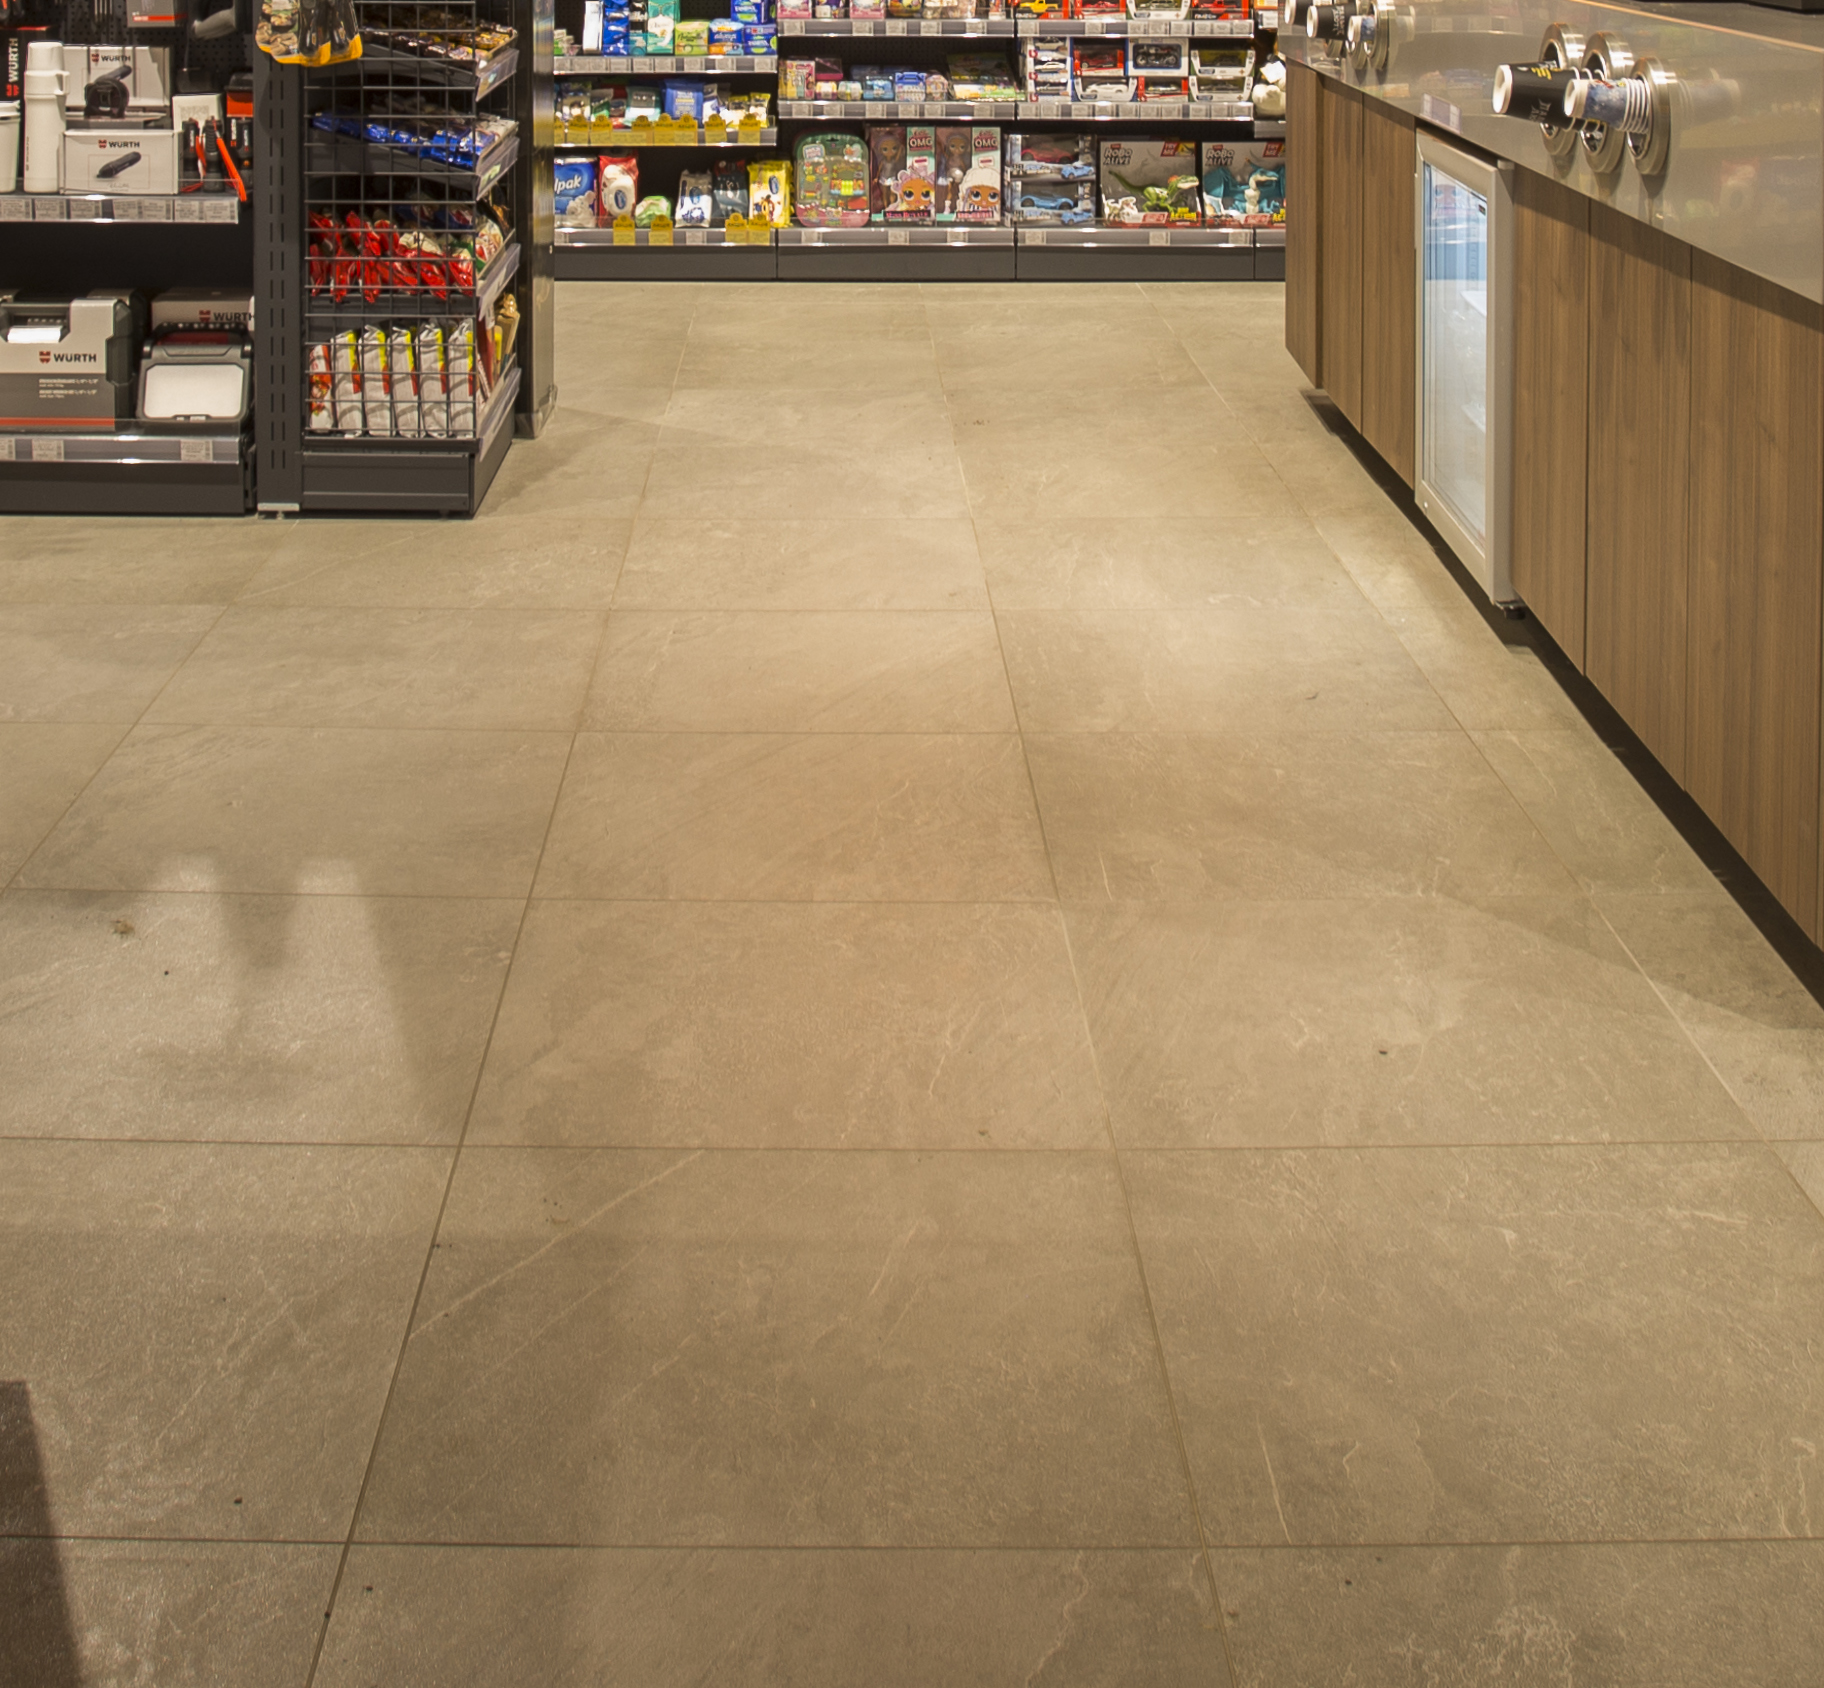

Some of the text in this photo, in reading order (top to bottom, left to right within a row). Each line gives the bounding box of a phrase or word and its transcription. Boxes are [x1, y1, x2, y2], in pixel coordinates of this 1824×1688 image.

[8, 37, 19, 83] WÜRTH
[101, 54, 131, 62] WÜRTH
[108, 140, 140, 149] WÜRTH
[909, 138, 932, 147] OMG
[975, 138, 998, 147] OMG
[1104, 148, 1133, 158] ROBO
[1206, 149, 1235, 158] ROBO
[213, 312, 255, 321] WÜRTH
[54, 353, 97, 363] WÜRTH
